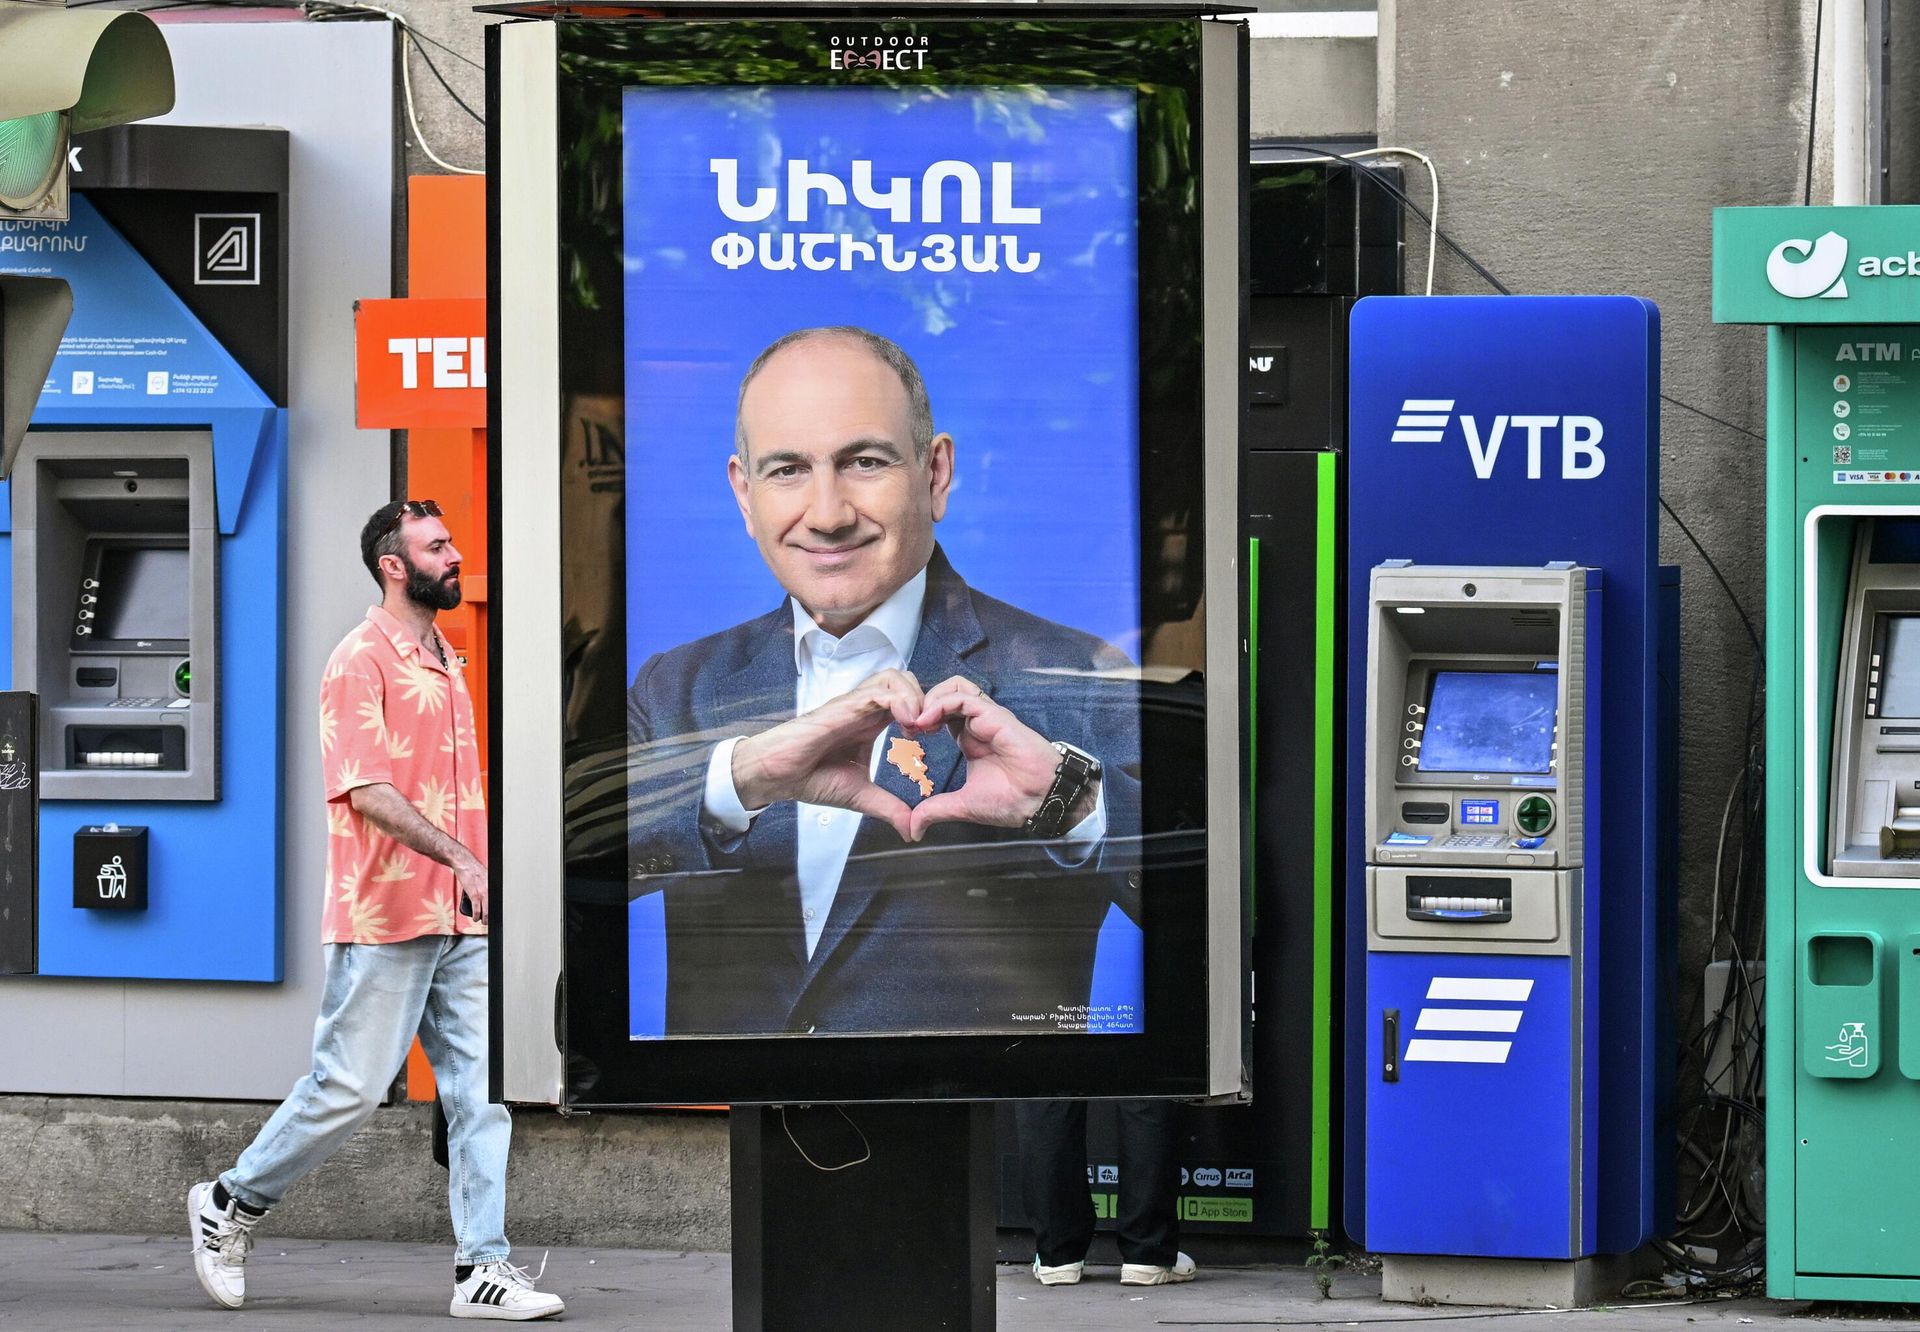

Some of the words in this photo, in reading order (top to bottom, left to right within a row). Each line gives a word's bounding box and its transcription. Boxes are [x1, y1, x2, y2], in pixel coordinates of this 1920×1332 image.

[830, 36, 929, 46] OUTDOOR
[709, 158, 1042, 225] ՆԻԿՈԼ
[710, 232, 1042, 274] ՓԱՇԻՆՅԱՆ
[1835, 343, 1900, 361] ATM
[1459, 415, 1606, 480] VTB
[1195, 1173, 1220, 1181] Cirrus
[1227, 1171, 1252, 1180] ArCa
[1201, 1207, 1220, 1218] App
[1222, 1208, 1248, 1217] Store
